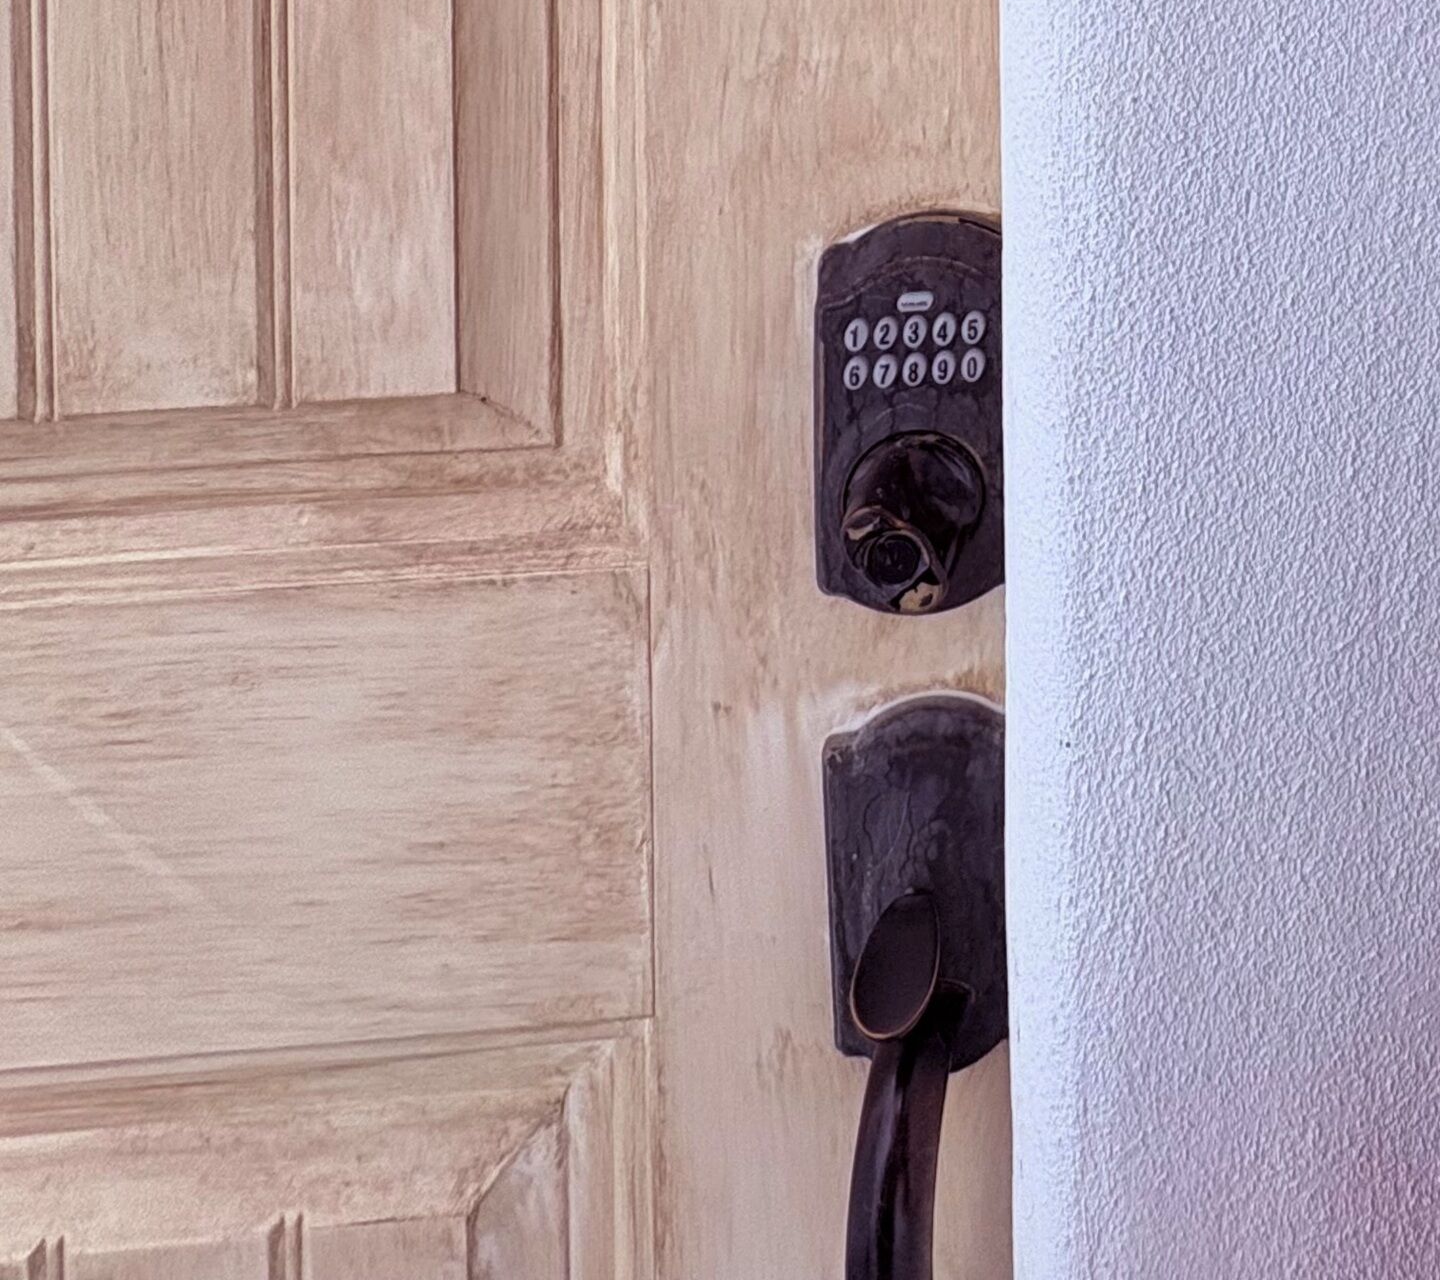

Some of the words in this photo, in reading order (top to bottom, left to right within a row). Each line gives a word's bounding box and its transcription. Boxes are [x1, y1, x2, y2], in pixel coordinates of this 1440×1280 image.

[849, 326, 859, 347] 1
[879, 324, 891, 345] 2
[908, 322, 920, 343] 3
[937, 321, 949, 342] 4
[967, 319, 979, 340] 5
[850, 366, 860, 386] 6
[879, 364, 891, 384] 7
[908, 362, 919, 383] 8
[937, 360, 949, 380] 9
[967, 357, 978, 378] 0
